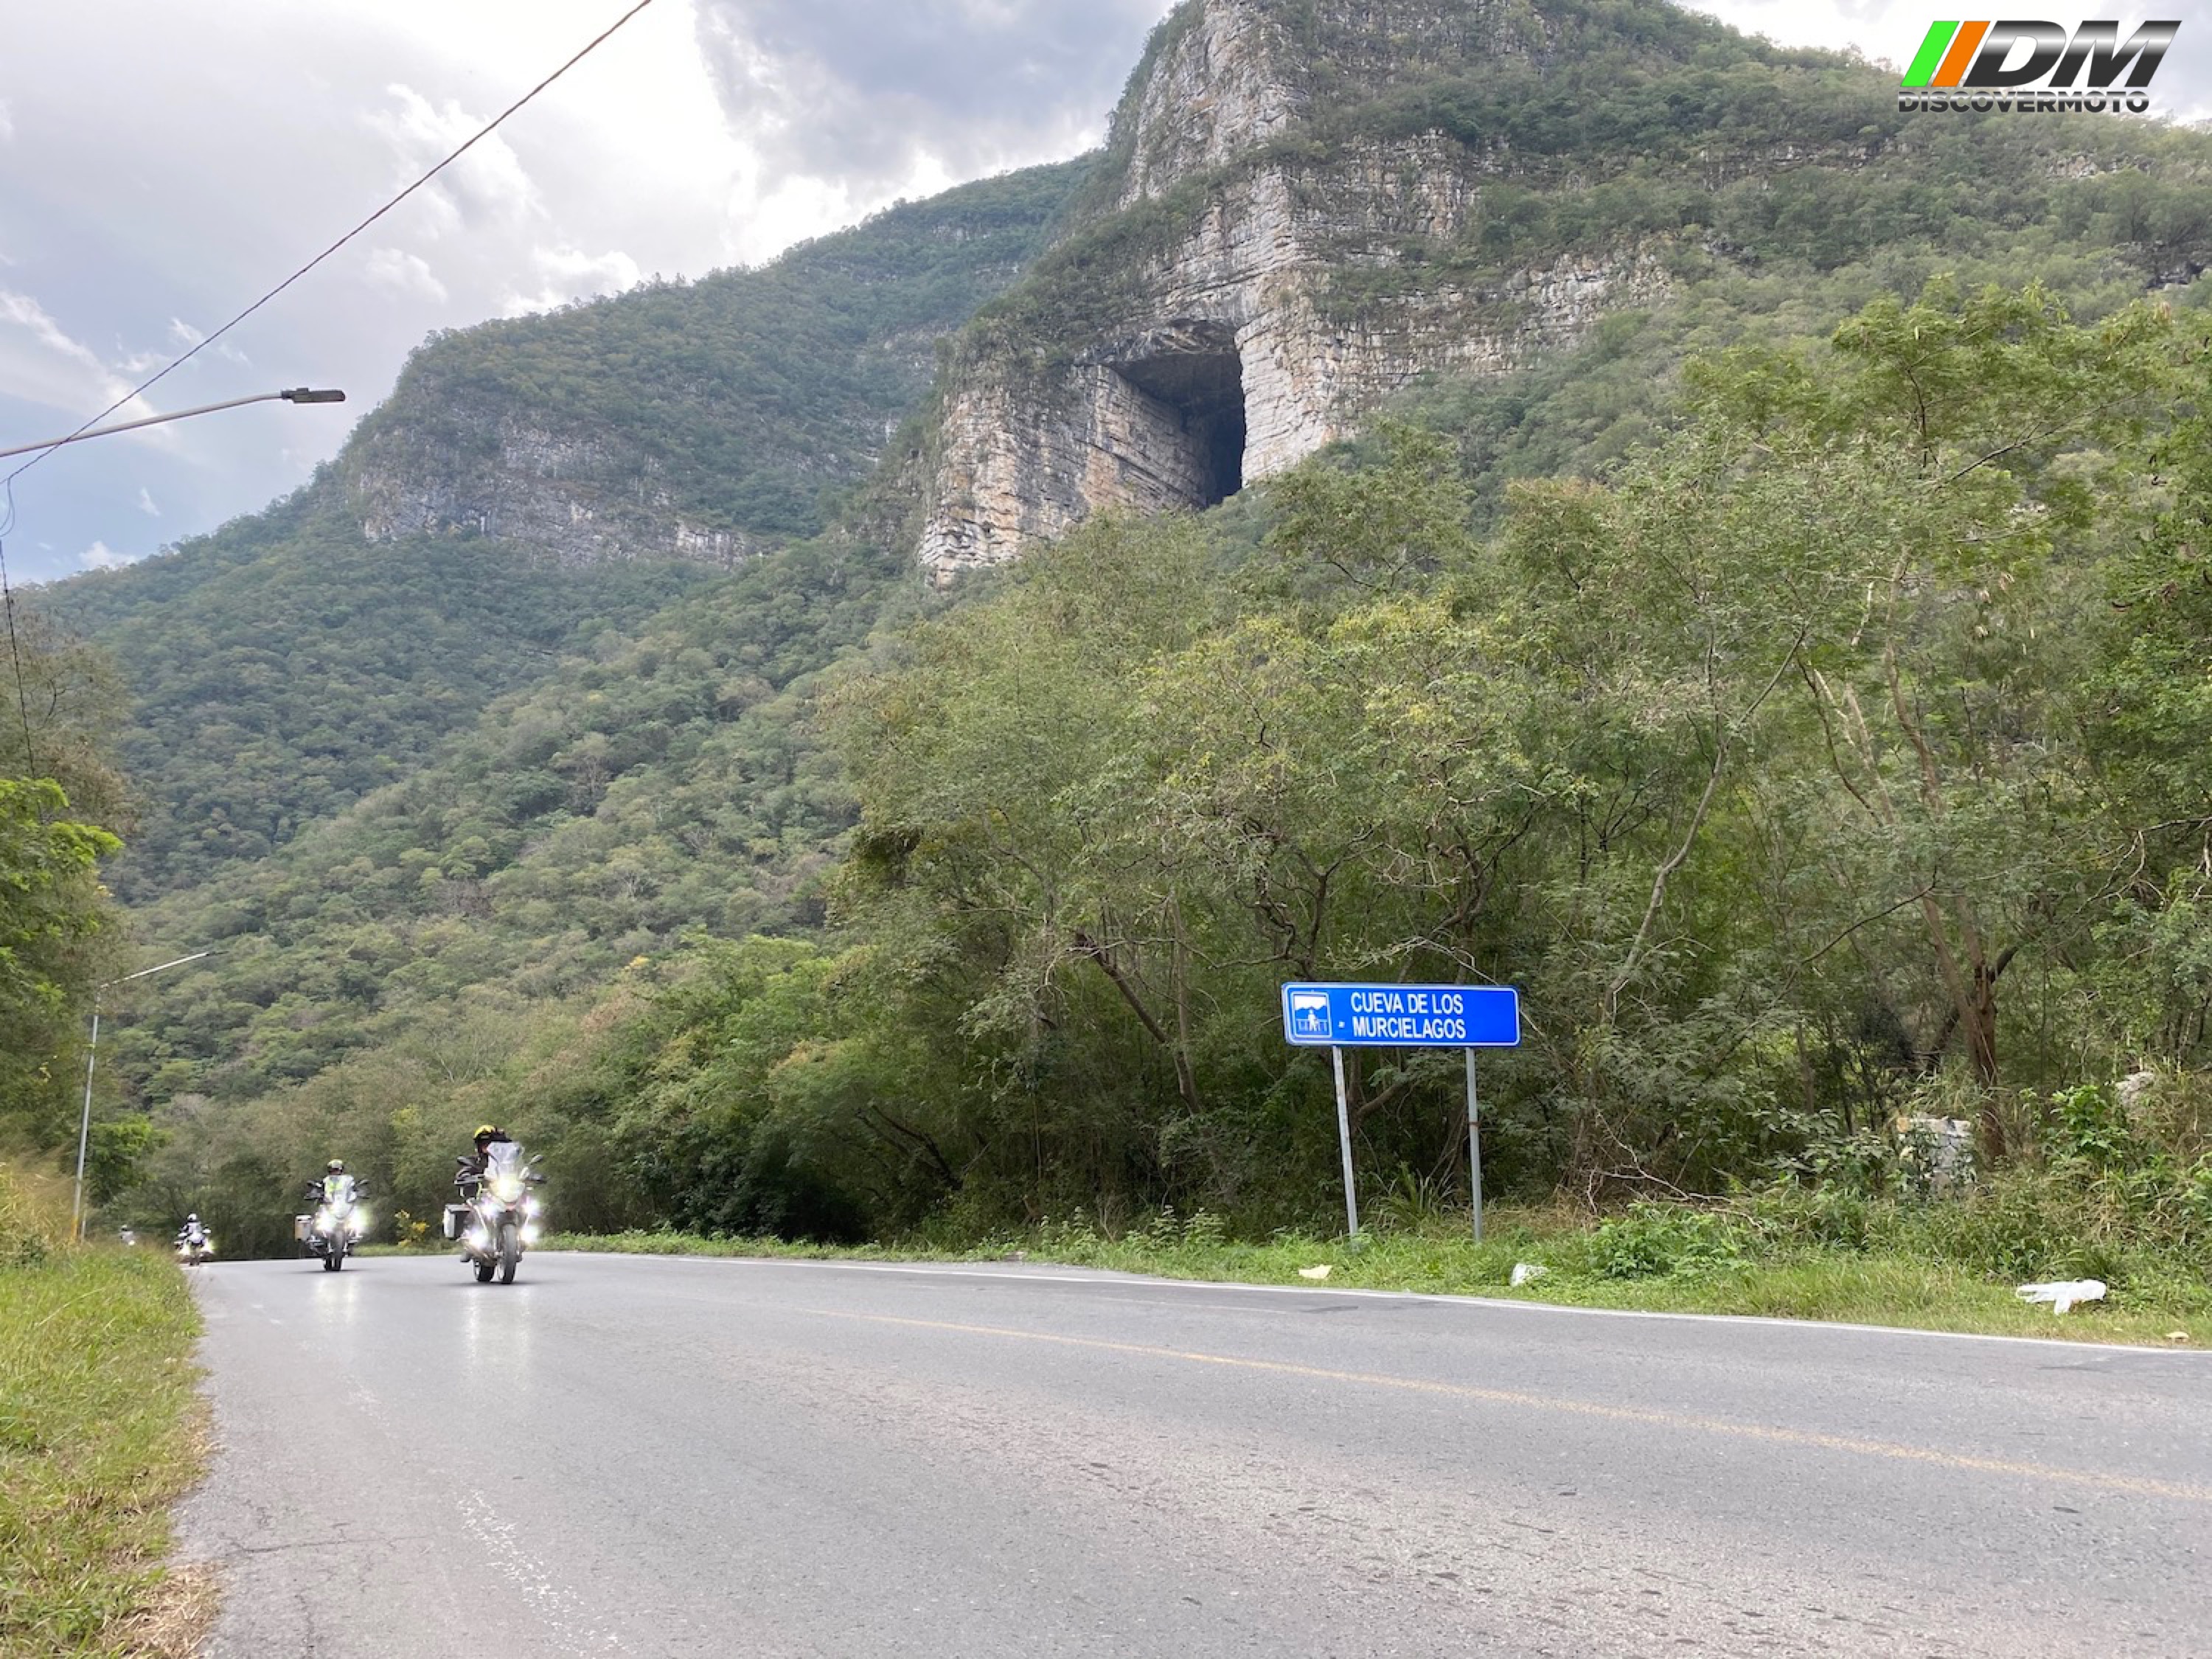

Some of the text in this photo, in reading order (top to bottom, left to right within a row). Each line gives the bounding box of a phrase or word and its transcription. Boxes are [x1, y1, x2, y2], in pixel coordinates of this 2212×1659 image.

[1350, 992, 1464, 1015] CUEVA DE LOS
[1352, 1016, 1466, 1039] MURCIELAGOS
